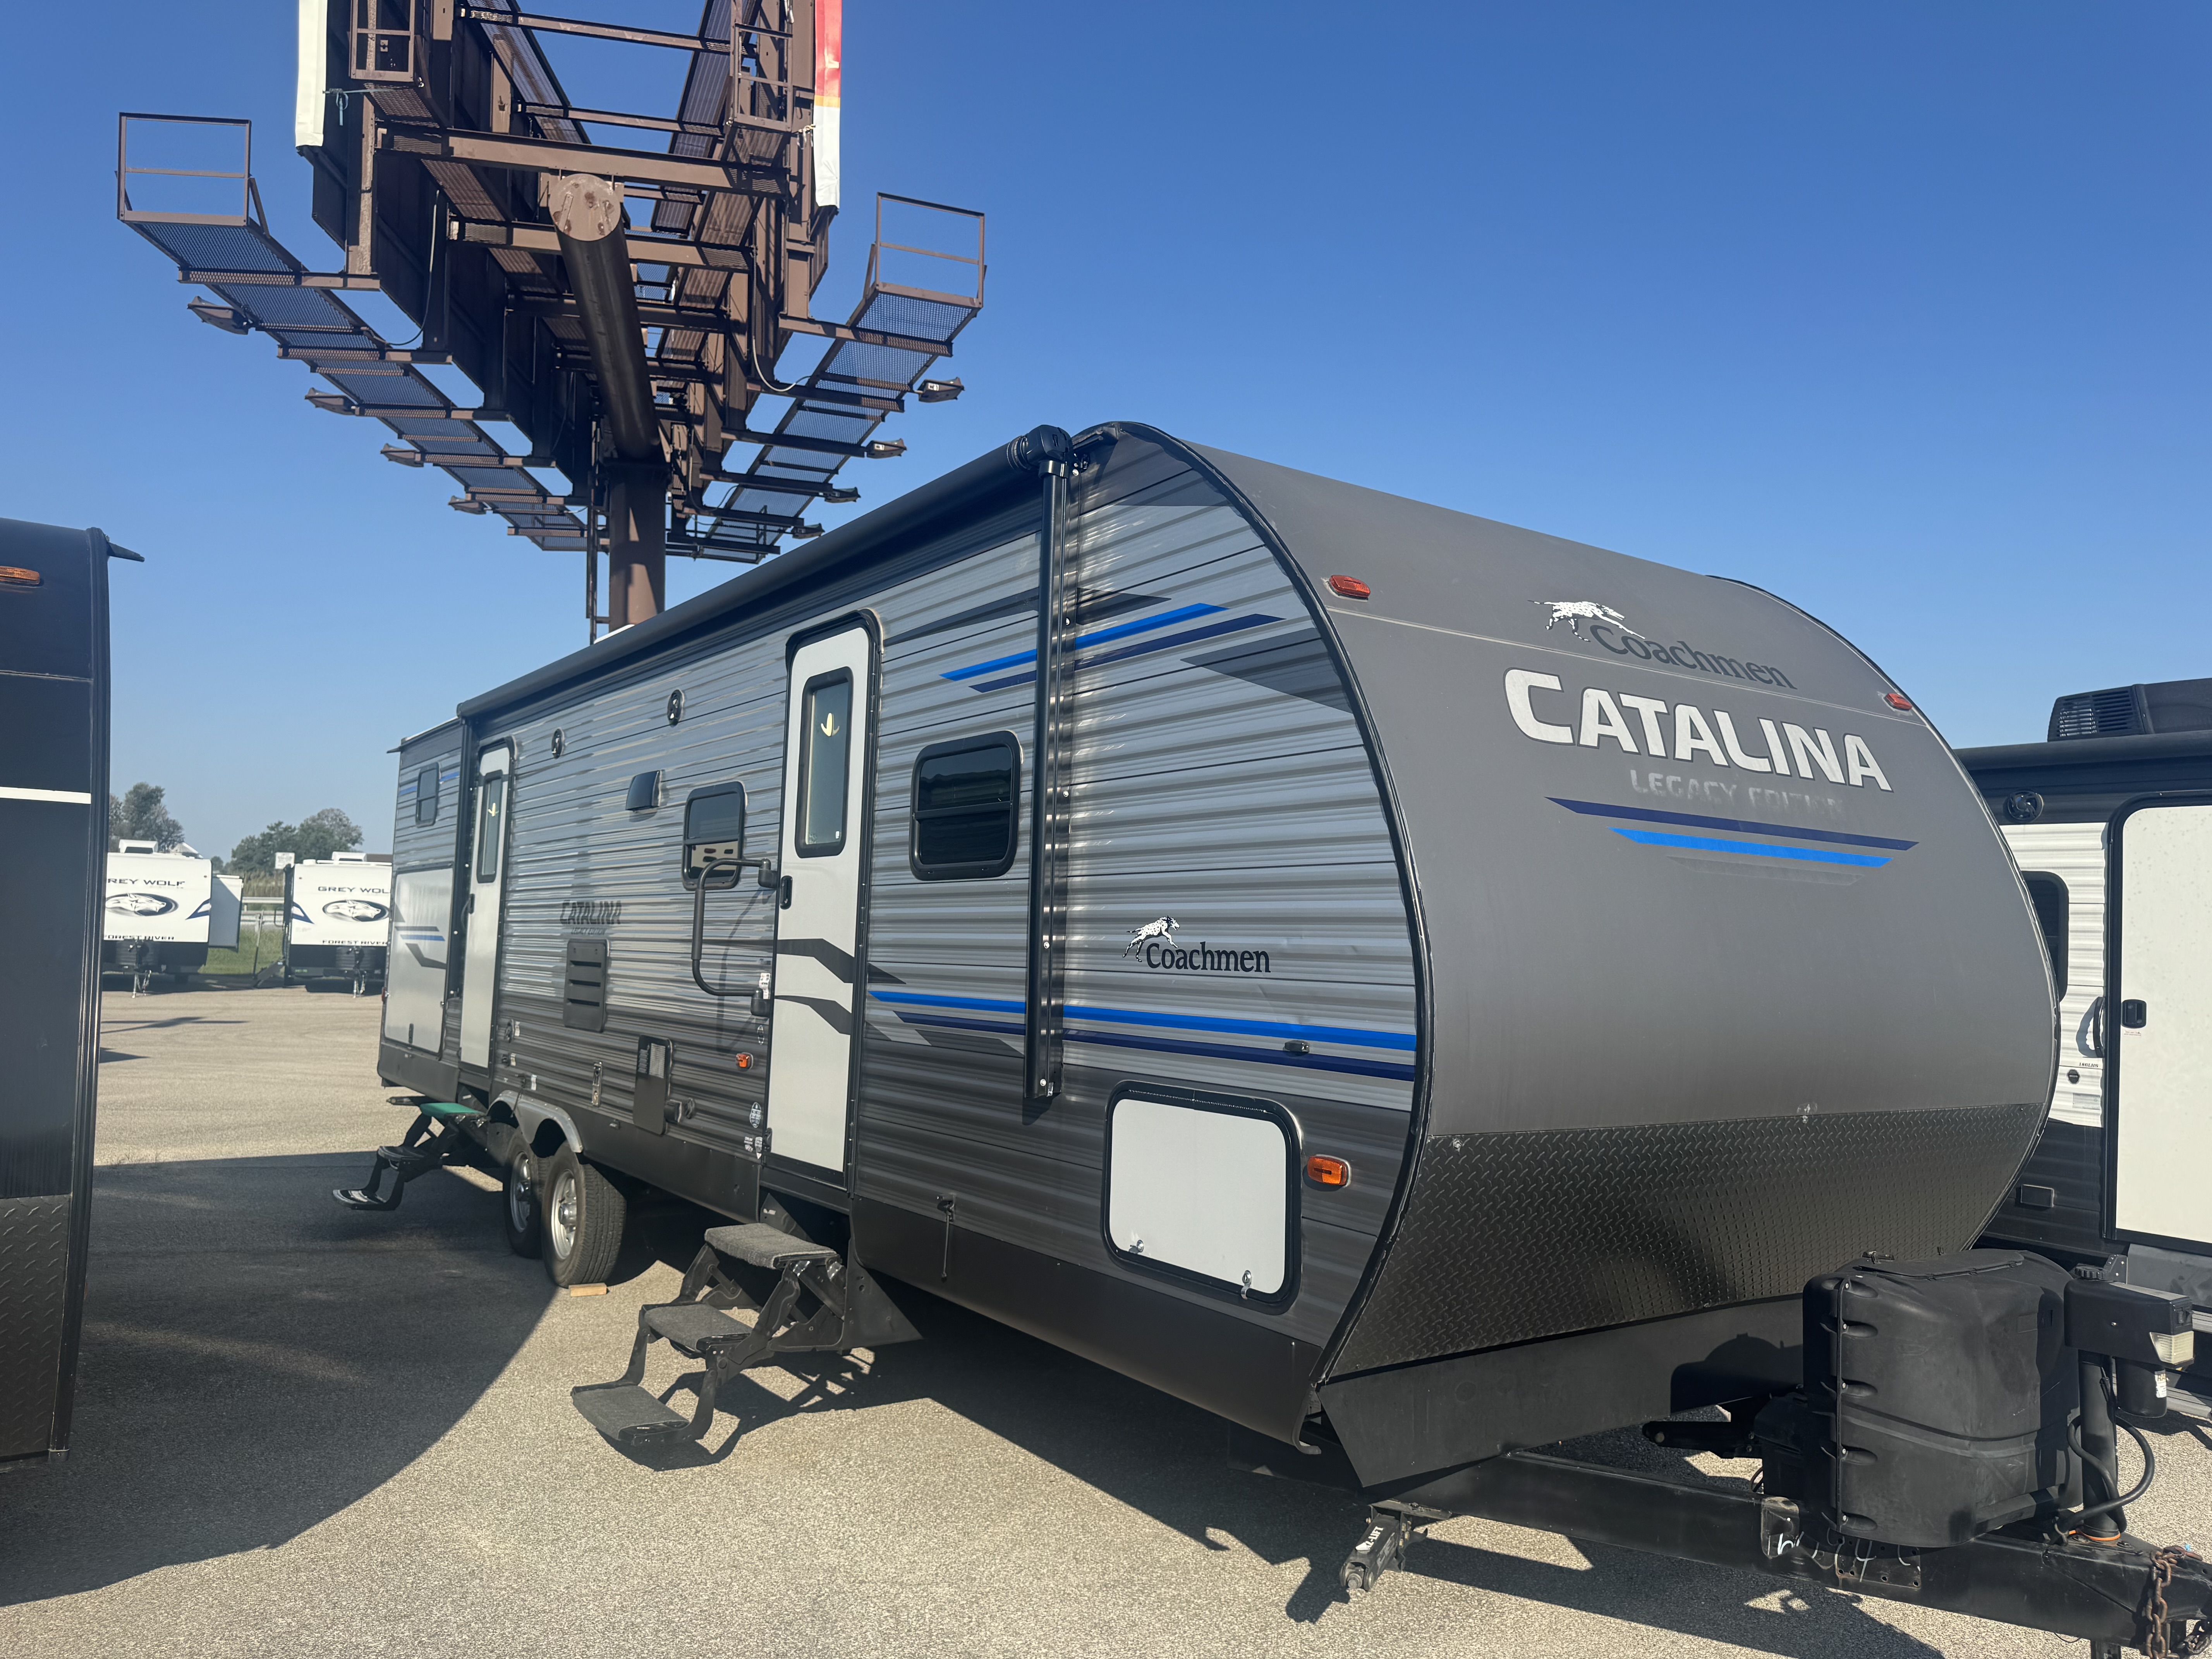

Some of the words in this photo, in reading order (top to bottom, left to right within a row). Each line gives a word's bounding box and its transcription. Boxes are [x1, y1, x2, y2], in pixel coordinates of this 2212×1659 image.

[1590, 625, 1797, 690] Coachmen
[1503, 667, 1893, 792] CATALINA
[560, 900, 622, 924] CATALINA
[1146, 941, 1271, 973] Coachmen
